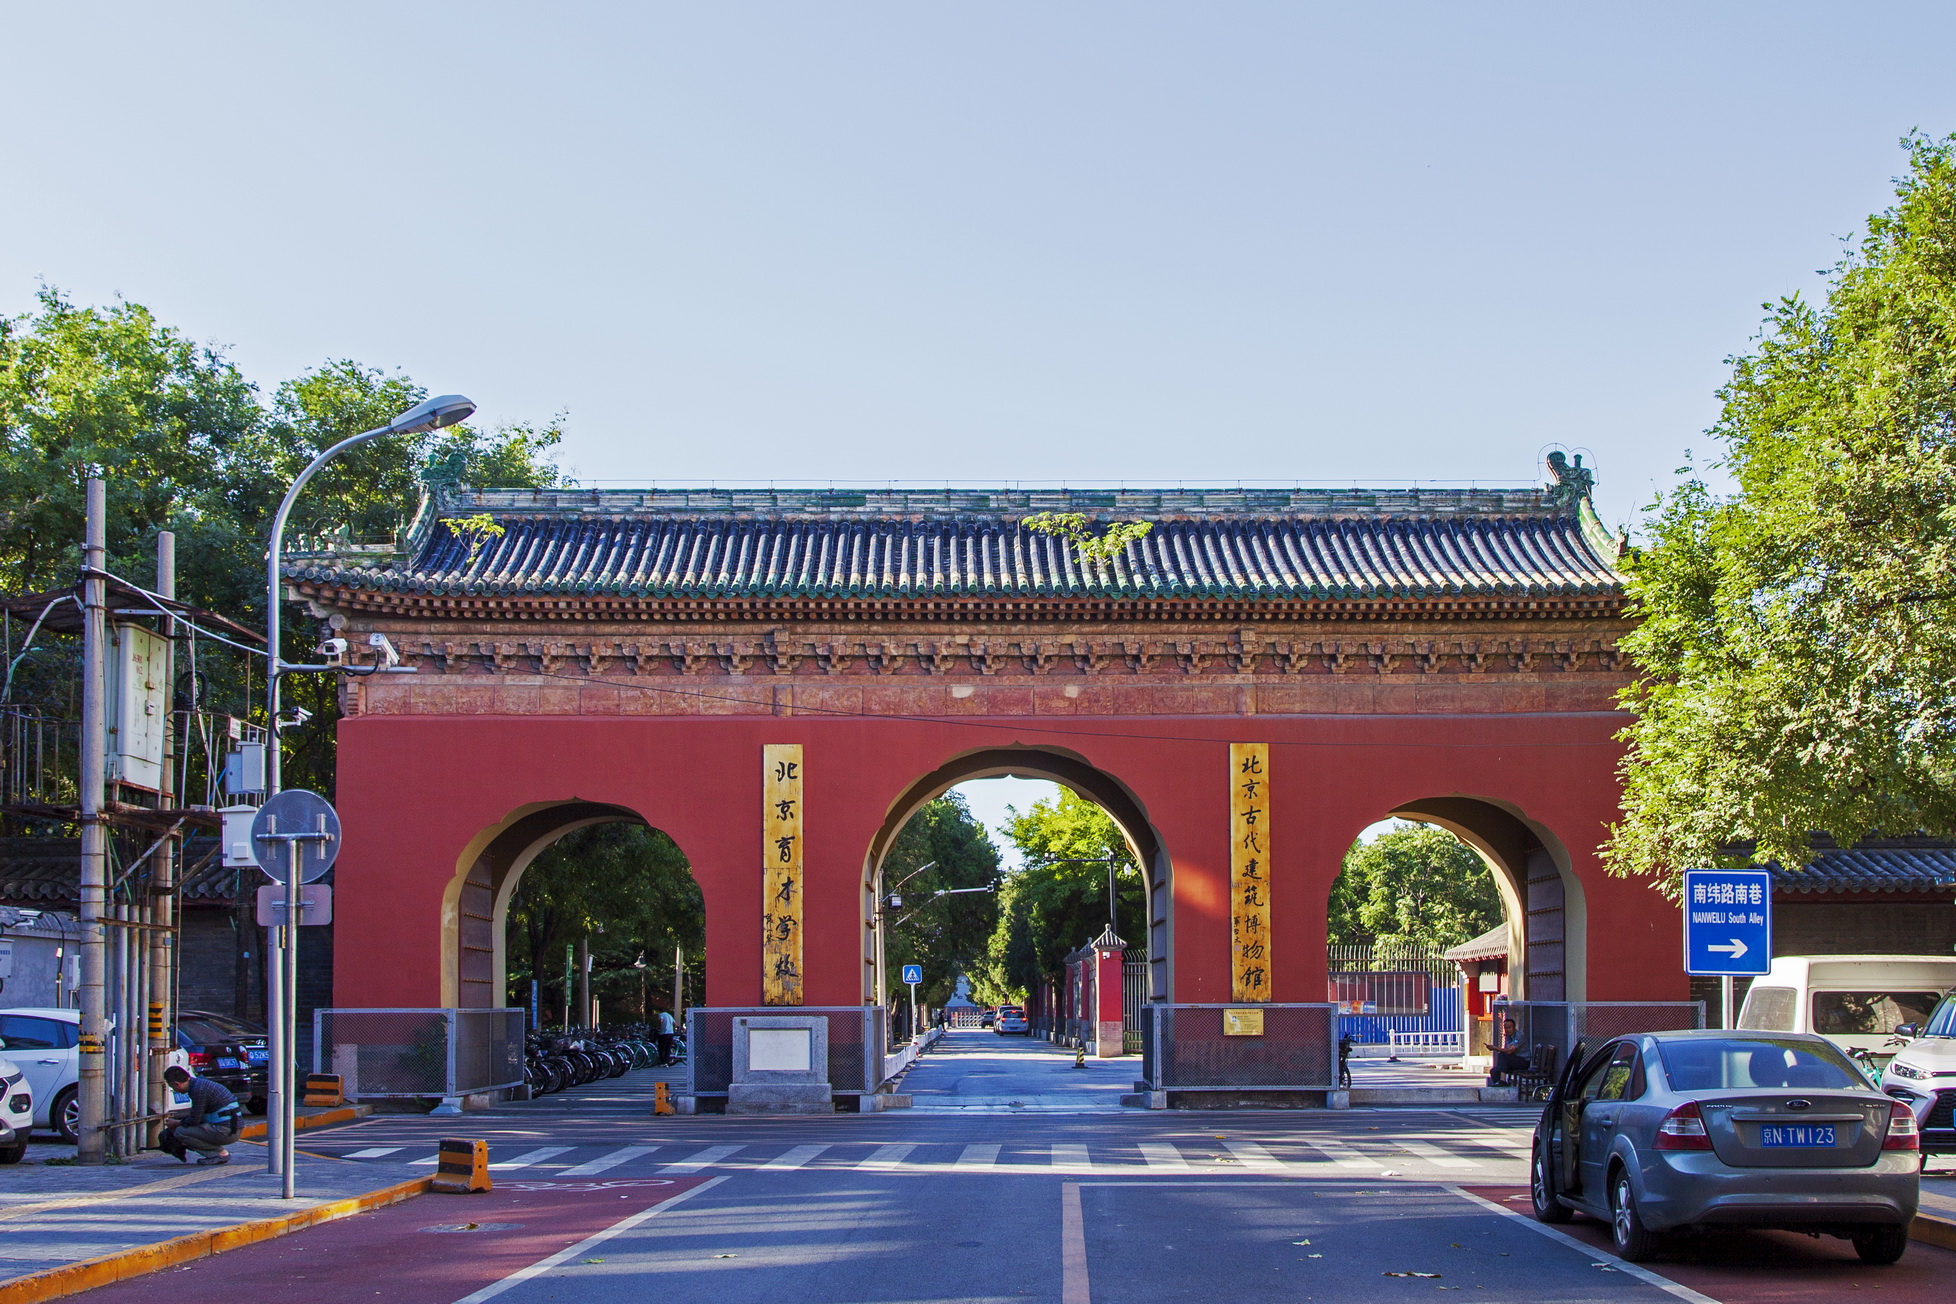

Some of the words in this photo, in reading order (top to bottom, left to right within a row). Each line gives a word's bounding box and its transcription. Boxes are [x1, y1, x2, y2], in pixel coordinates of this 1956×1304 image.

[774, 760, 798, 978] 北京育才学校
[1693, 883, 1762, 905] 南纬路南巷
[1693, 912, 1726, 924] NANWEILU
[1728, 912, 1746, 924] South
[1749, 912, 1764, 926] Alley
